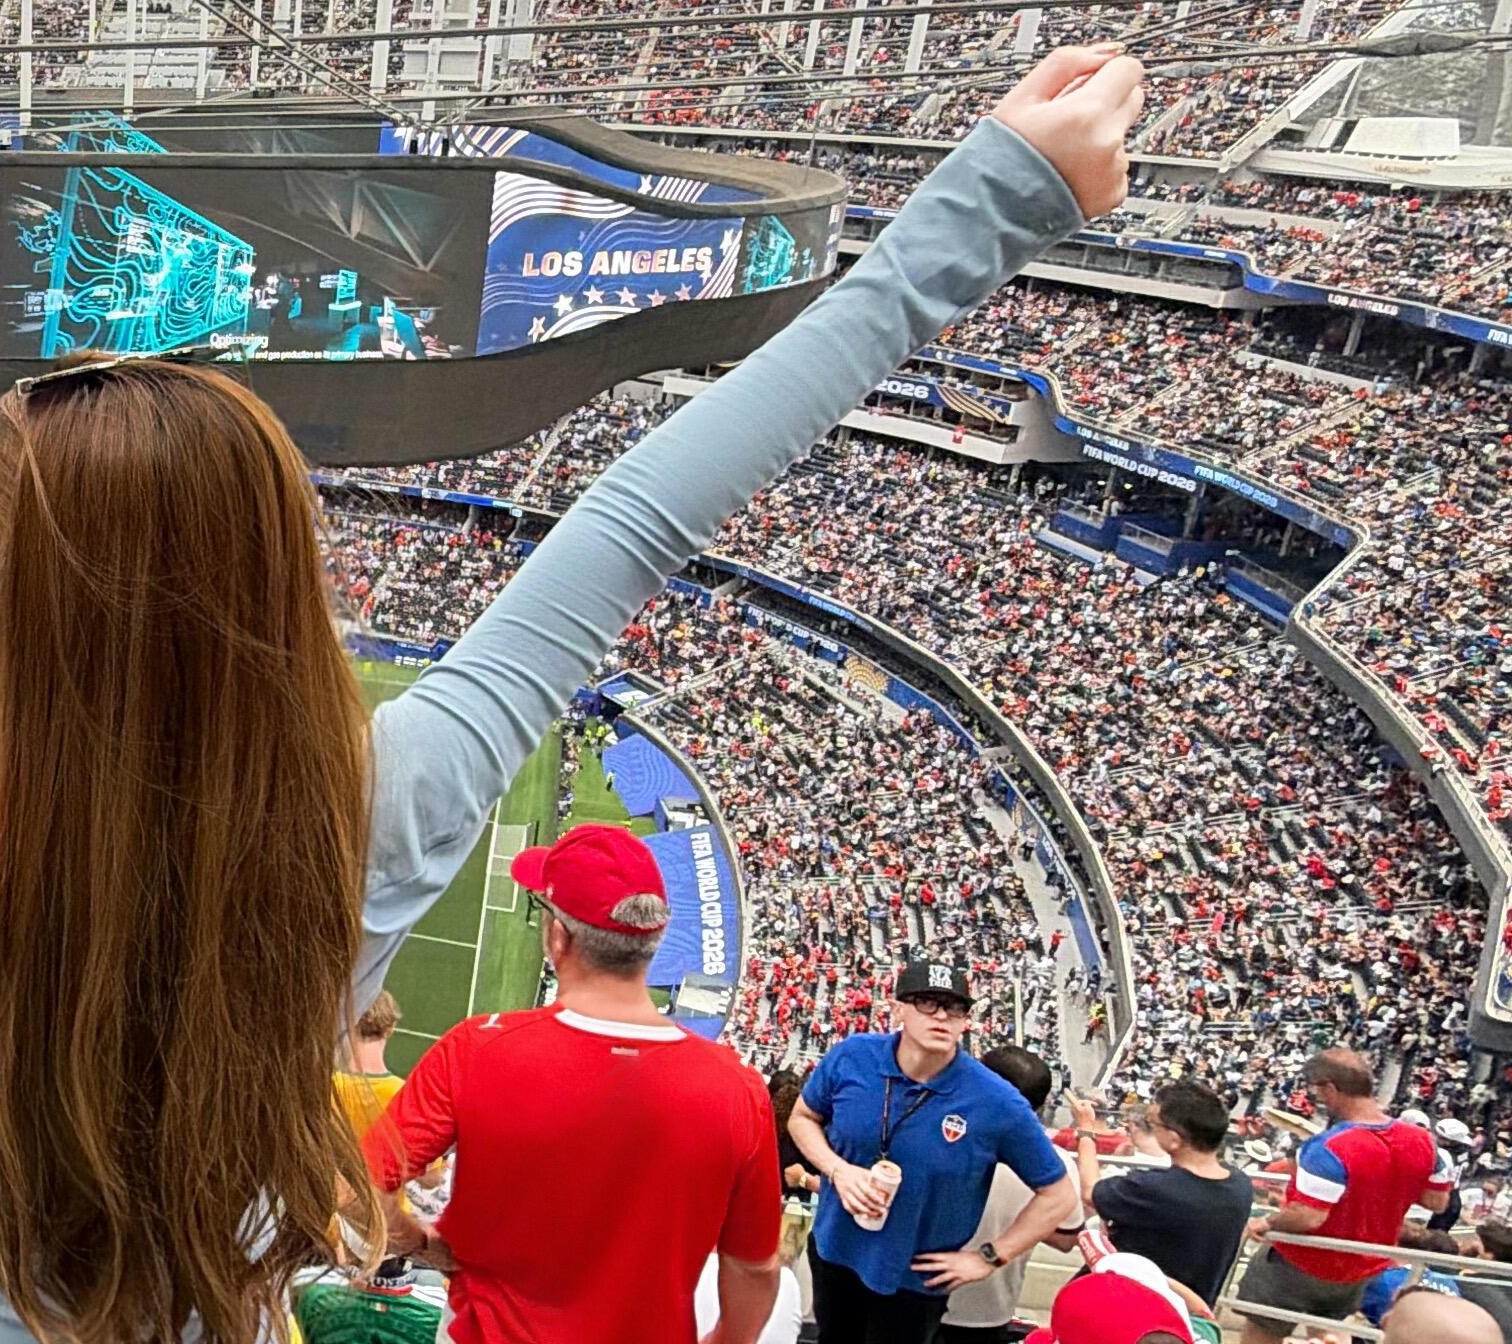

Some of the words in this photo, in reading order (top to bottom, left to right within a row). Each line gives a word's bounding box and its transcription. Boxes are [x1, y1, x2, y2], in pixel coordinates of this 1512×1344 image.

[522, 251, 584, 277] LOS
[589, 246, 713, 276] ANGELES
[1328, 292, 1349, 307] LOS
[209, 332, 269, 349] Optimizing
[875, 379, 929, 399] 2026
[1083, 444, 1103, 462] FIFA
[1102, 452, 1138, 473] WORLD
[1137, 463, 1159, 479] CUP
[1157, 470, 1197, 492] 2026
[1194, 465, 1214, 480] FIFA
[690, 831, 713, 859] FIFA
[694, 857, 721, 902] WORLD
[700, 902, 723, 928] CUP
[702, 928, 726, 976] 2026
